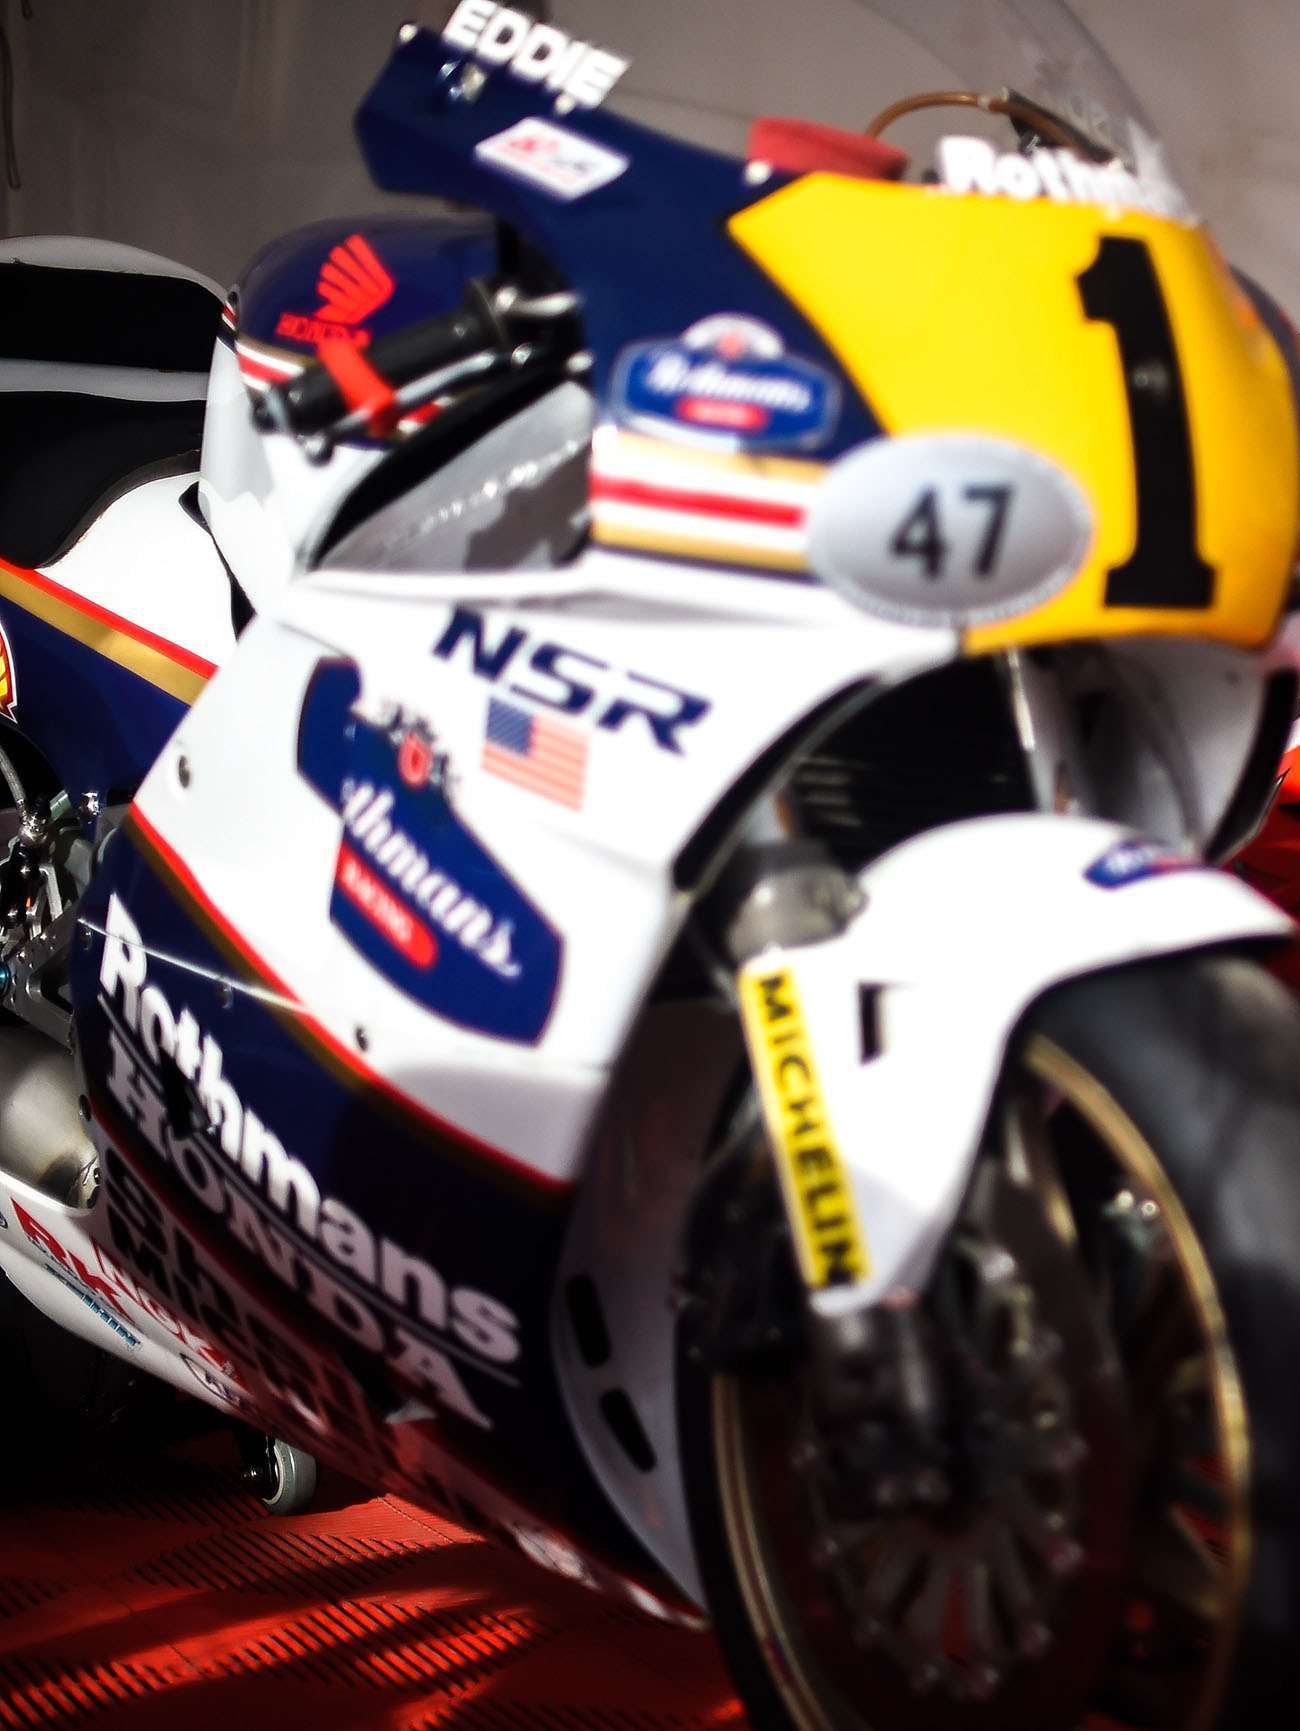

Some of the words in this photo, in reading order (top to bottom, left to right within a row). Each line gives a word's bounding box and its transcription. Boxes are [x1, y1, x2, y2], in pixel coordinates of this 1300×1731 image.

[441, 0, 630, 108] EDDIE
[1073, 235, 1218, 609] 1
[886, 483, 1016, 582] 47
[432, 604, 713, 755] NSR
[341, 778, 523, 980] thmans
[97, 890, 522, 1365] Rothmans
[757, 974, 860, 1288] MICHELIN
[10, 1196, 137, 1328] RK
[106, 1030, 494, 1430] HONDA
